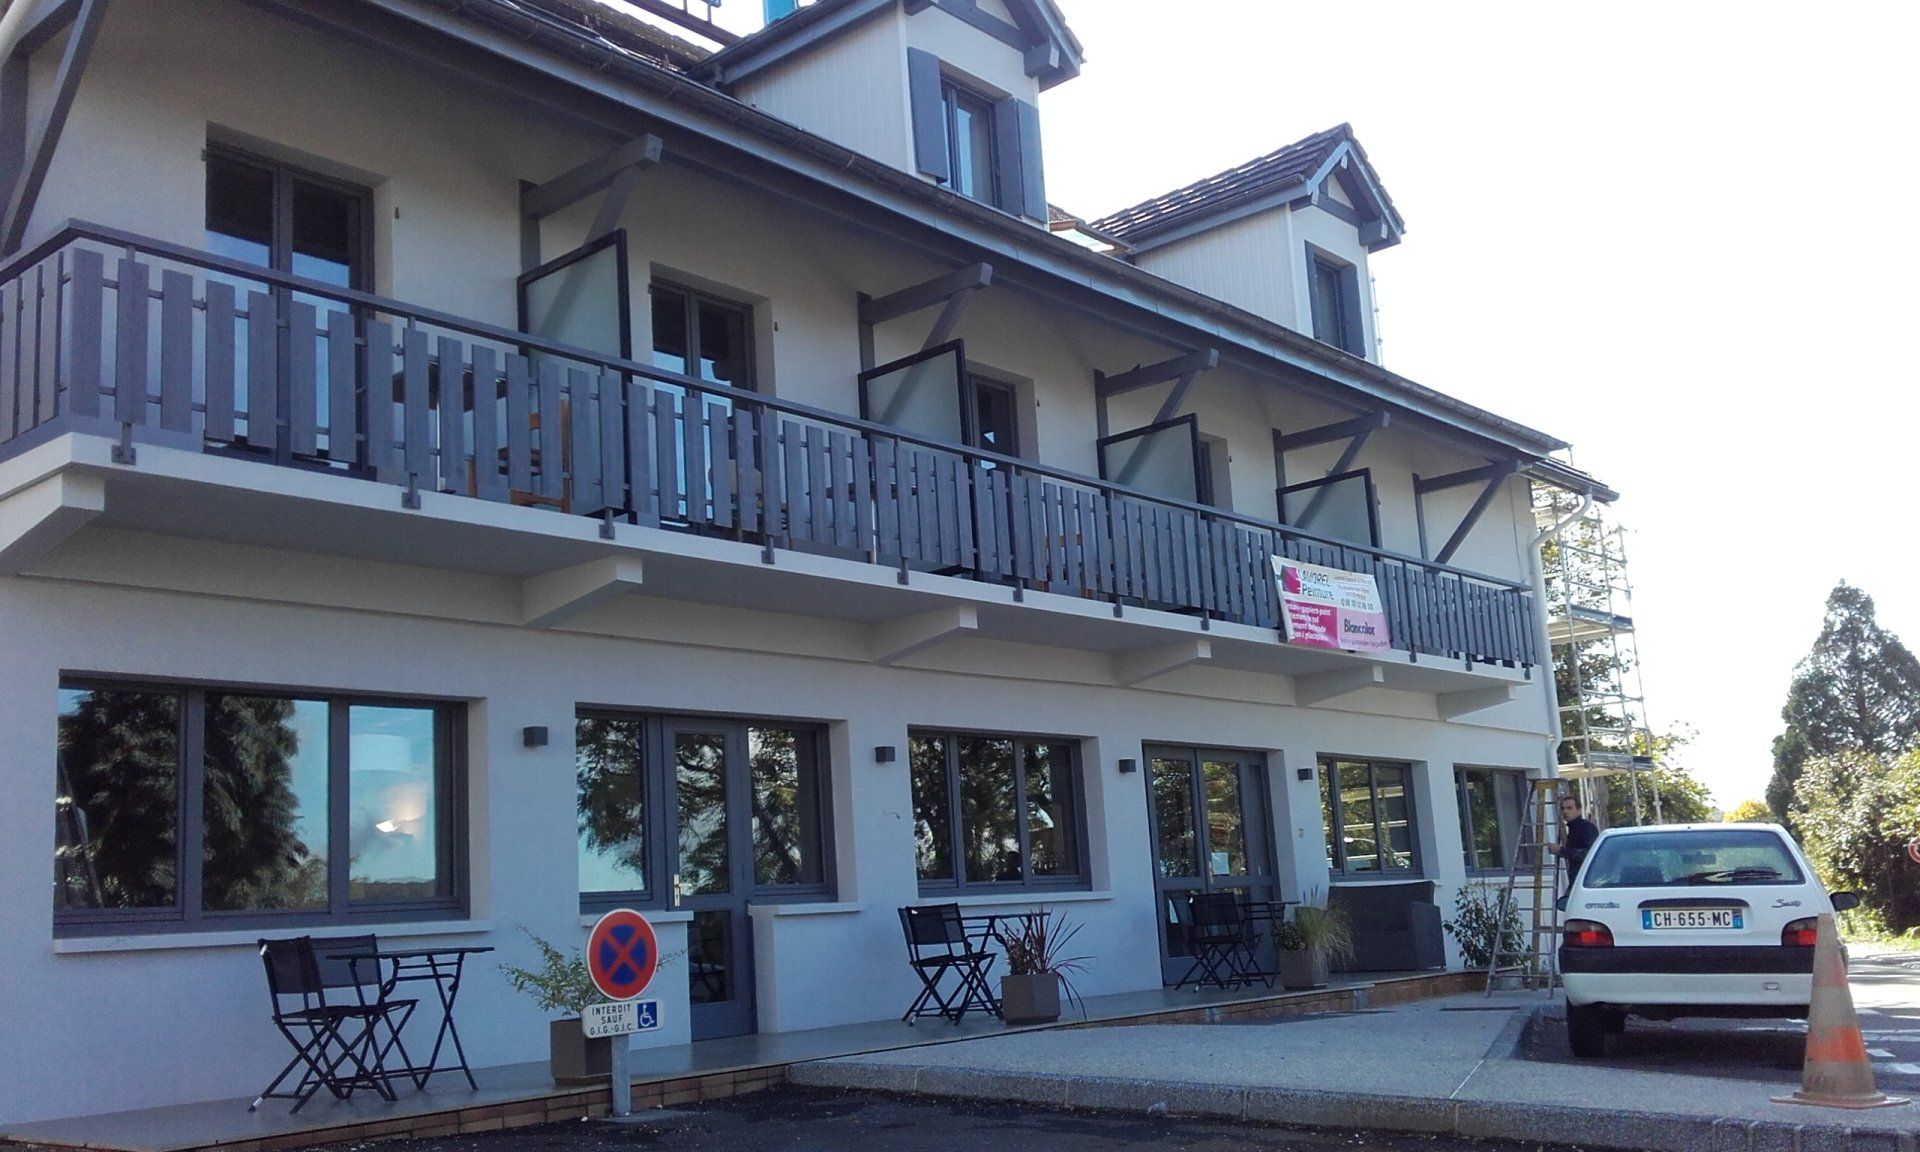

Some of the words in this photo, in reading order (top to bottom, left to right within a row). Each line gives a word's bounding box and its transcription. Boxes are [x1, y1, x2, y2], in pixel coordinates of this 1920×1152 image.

[1343, 618, 1375, 636] Blancolor
[1654, 911, 1731, 928] CH-655-MC
[592, 1003, 632, 1016] INTERDIT
[601, 1014, 623, 1025] SAUF
